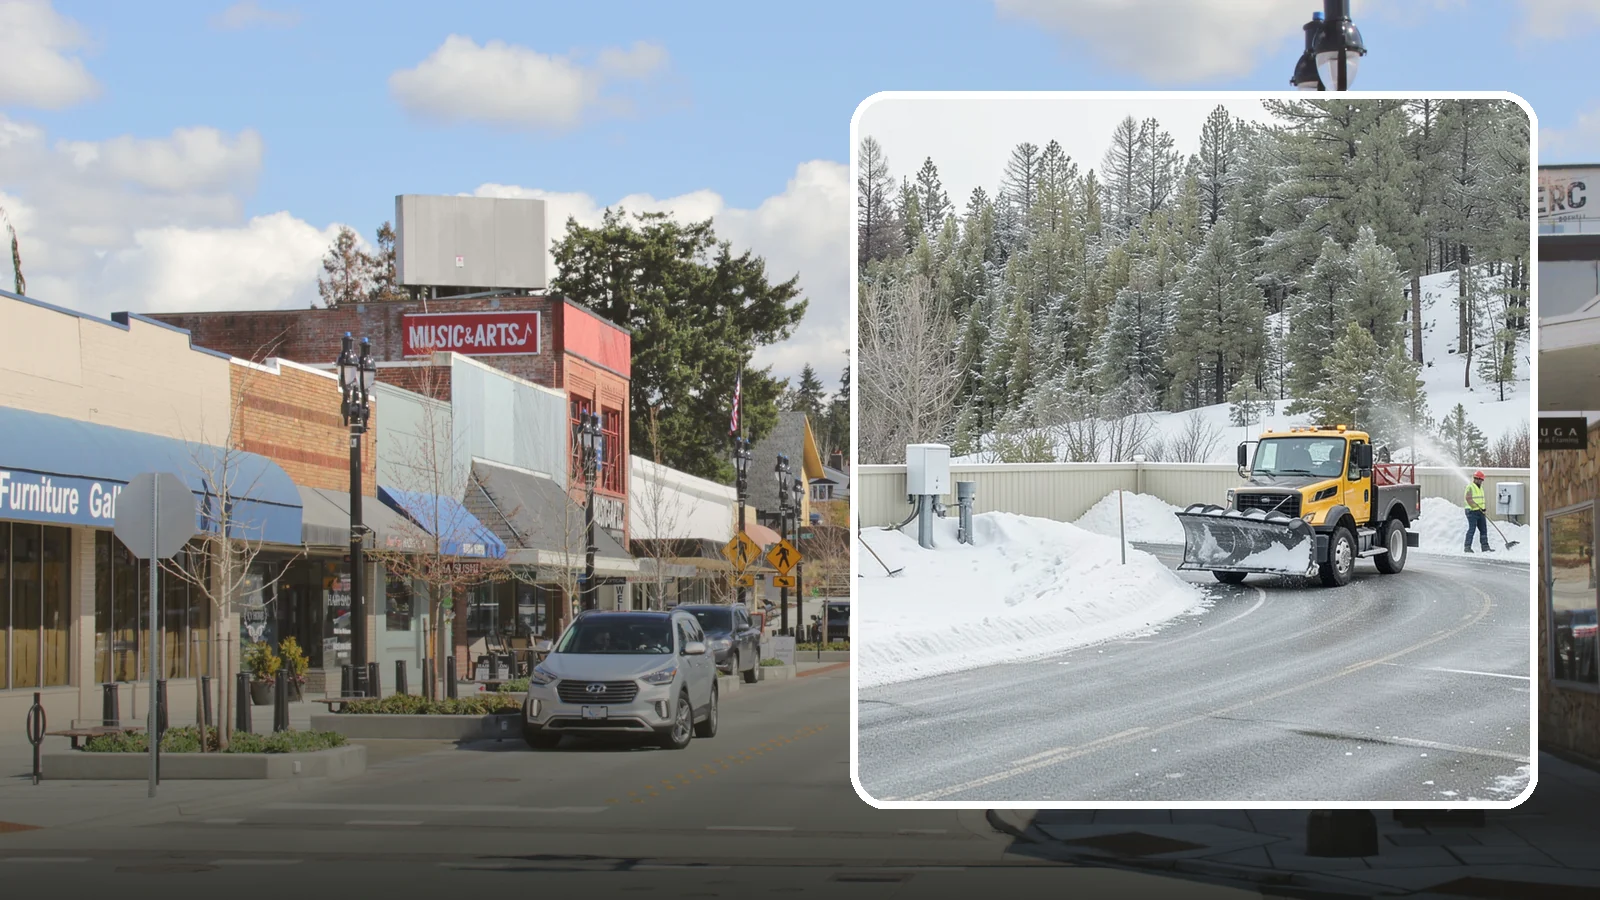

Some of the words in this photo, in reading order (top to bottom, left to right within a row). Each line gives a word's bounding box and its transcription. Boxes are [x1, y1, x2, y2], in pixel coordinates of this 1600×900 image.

[408, 322, 520, 349] MUSIC&ARTS
[1540, 428, 1577, 436] UGA
[0, 472, 79, 515] Furniture
[89, 482, 121, 519] Gal
[453, 563, 479, 574] SUSHI
